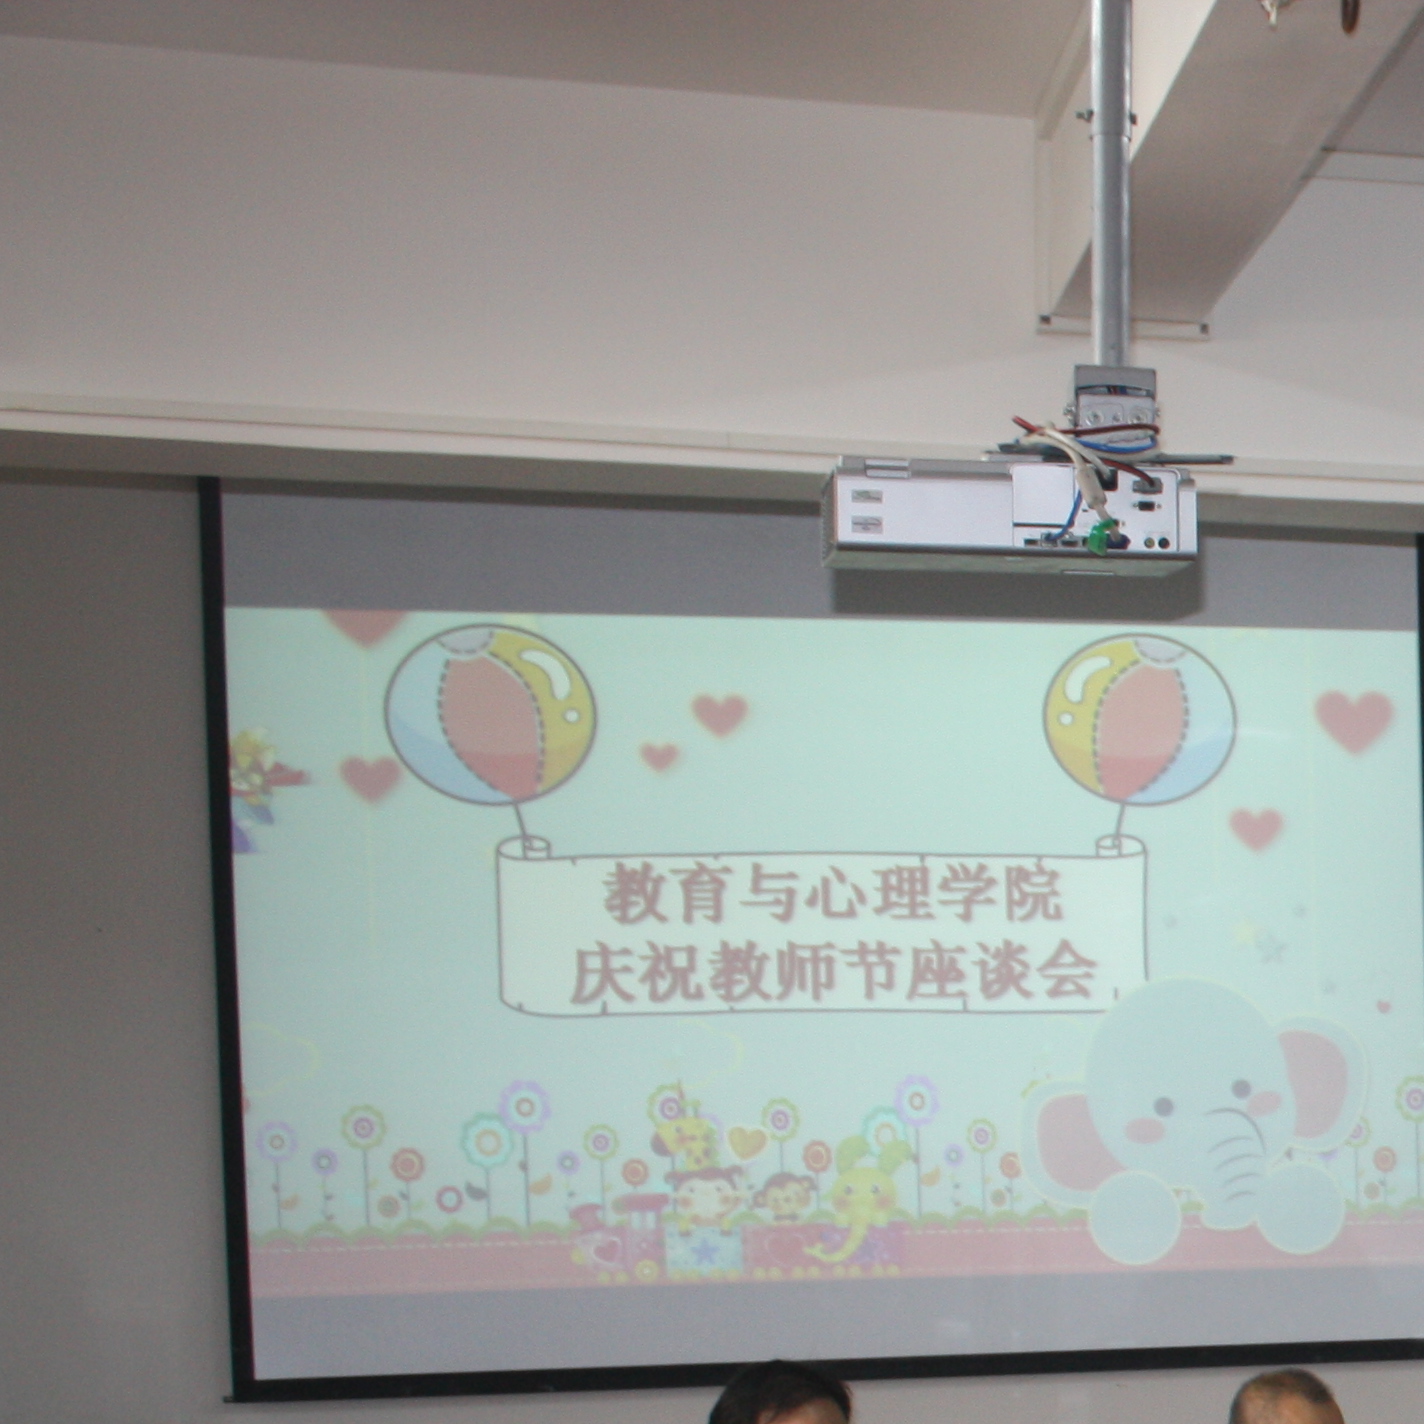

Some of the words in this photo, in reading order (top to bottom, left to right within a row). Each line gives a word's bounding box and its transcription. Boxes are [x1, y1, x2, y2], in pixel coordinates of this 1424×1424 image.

[602, 861, 1066, 925] 教育与心理学院
[569, 938, 1099, 1004] 庆祝教师节座谈会
